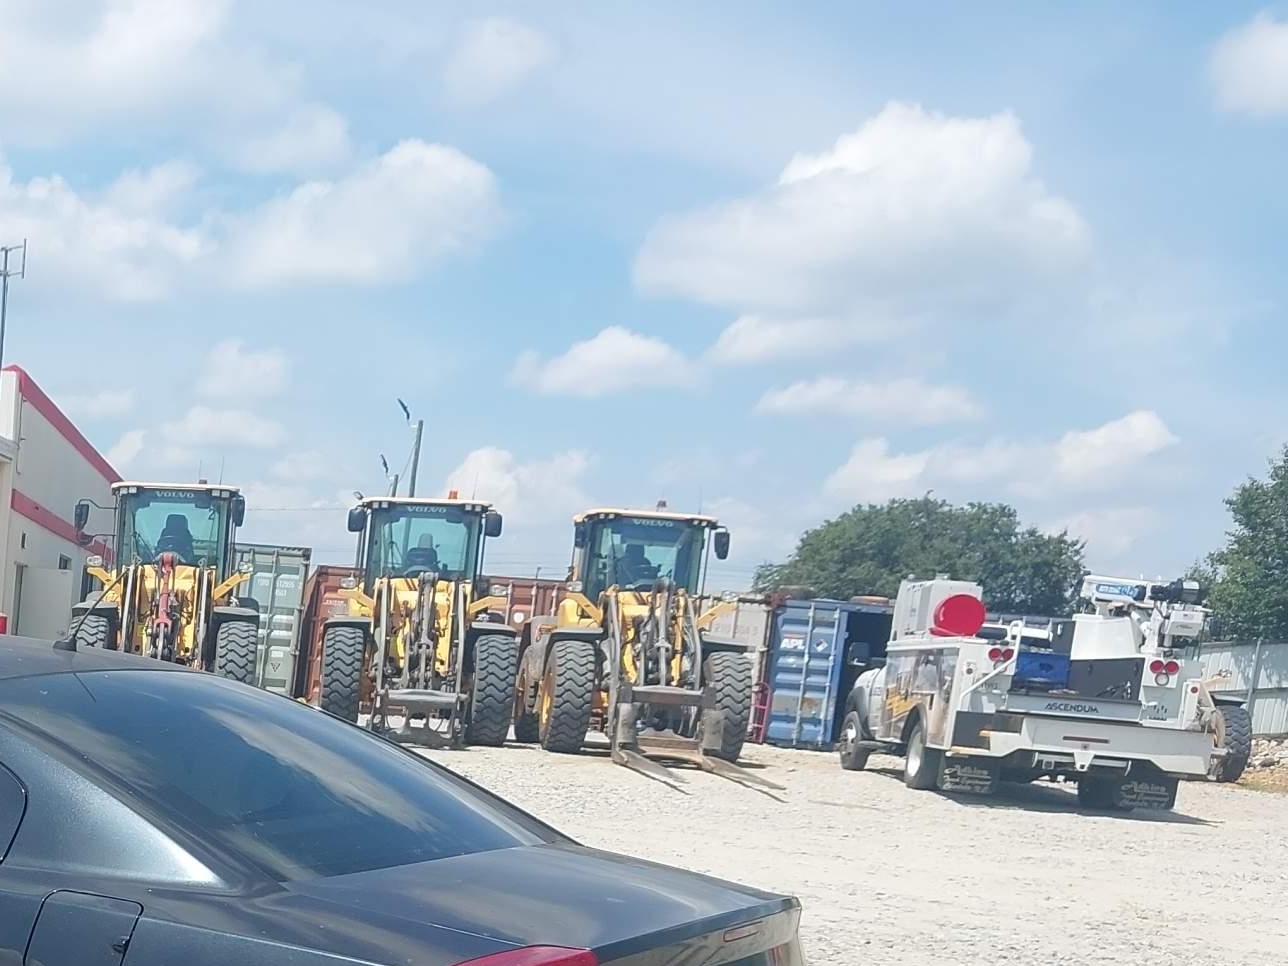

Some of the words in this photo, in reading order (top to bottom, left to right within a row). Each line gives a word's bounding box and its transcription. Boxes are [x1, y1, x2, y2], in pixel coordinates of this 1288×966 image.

[155, 490, 194, 499] VOLVO
[407, 505, 447, 514] VOLVO
[631, 518, 673, 528] VOLVO
[780, 638, 805, 650] APL
[1045, 702, 1100, 714] ASCENDUM
